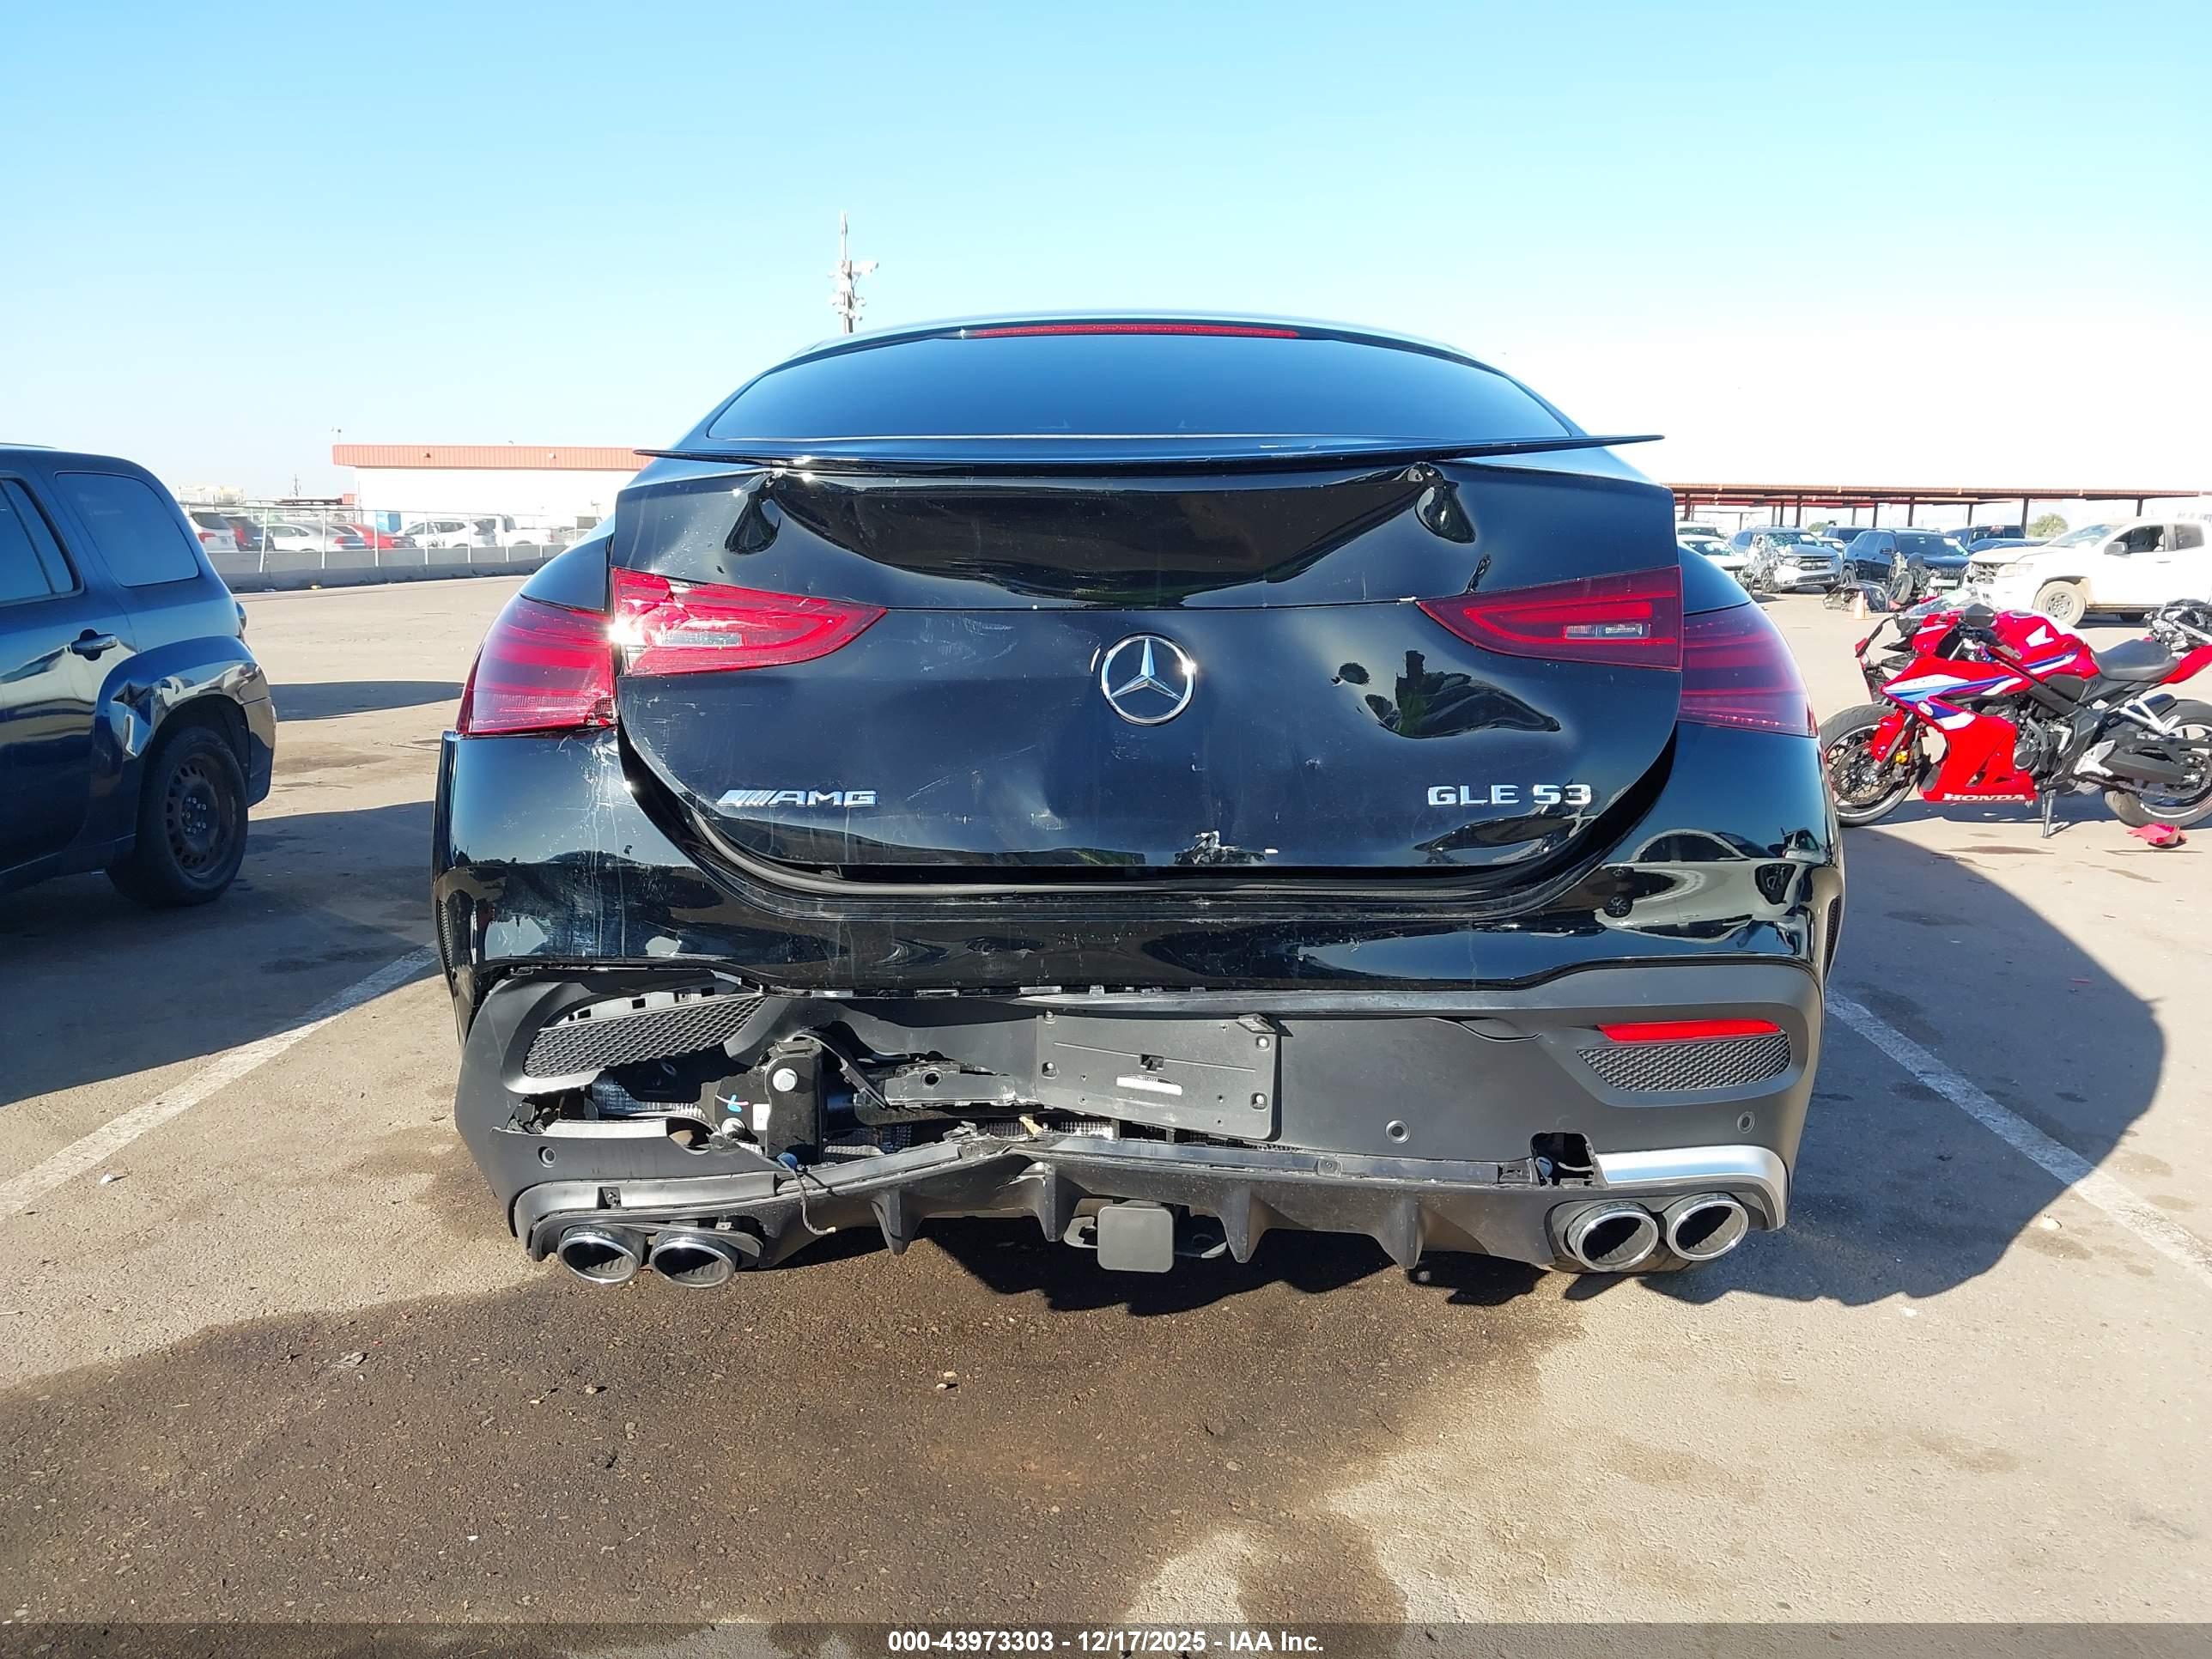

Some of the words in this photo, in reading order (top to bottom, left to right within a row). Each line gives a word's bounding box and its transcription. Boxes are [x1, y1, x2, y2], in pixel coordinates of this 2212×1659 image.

[765, 789, 878, 807] AMG
[1427, 784, 1520, 805] GLE
[1532, 784, 1592, 805] 53
[1942, 793, 2027, 801] HONDA
